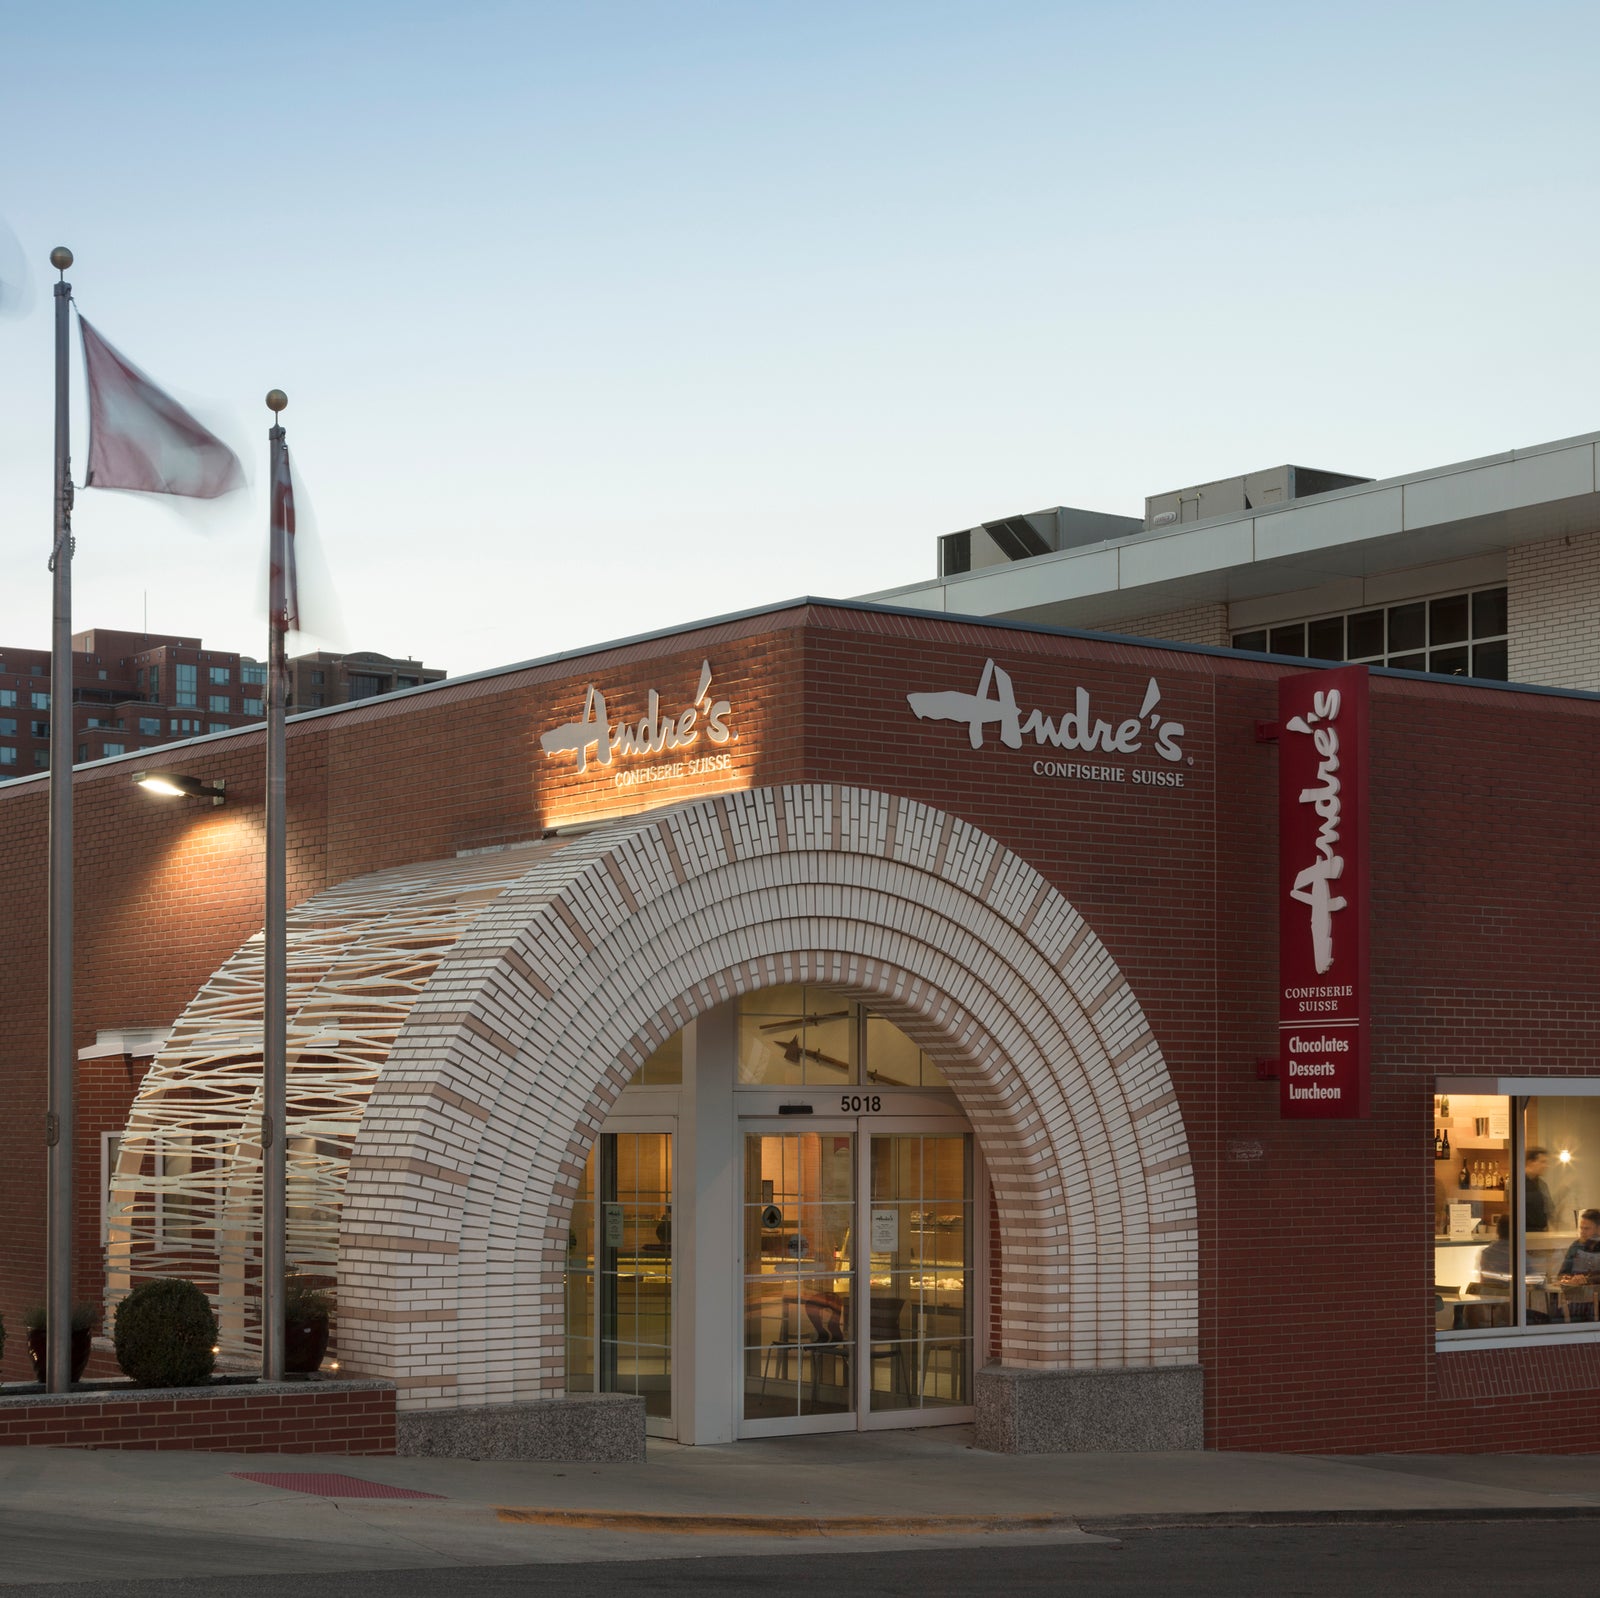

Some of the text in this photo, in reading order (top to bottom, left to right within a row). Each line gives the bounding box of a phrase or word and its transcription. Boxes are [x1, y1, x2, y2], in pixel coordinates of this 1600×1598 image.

[540, 659, 731, 774] André's
[906, 657, 1185, 762] André's
[614, 753, 732, 787] CONFISERIE SUISSE
[1033, 760, 1184, 787] CONFISERIE SUISSE
[1285, 985, 1353, 999] CONFISERIE
[1299, 1000, 1338, 1012] SUISSE
[1289, 1035, 1349, 1053] Chocolates
[1289, 1060, 1335, 1077] Desserts
[1289, 1082, 1341, 1100] Luncheon
[841, 1095, 881, 1112] 5018
